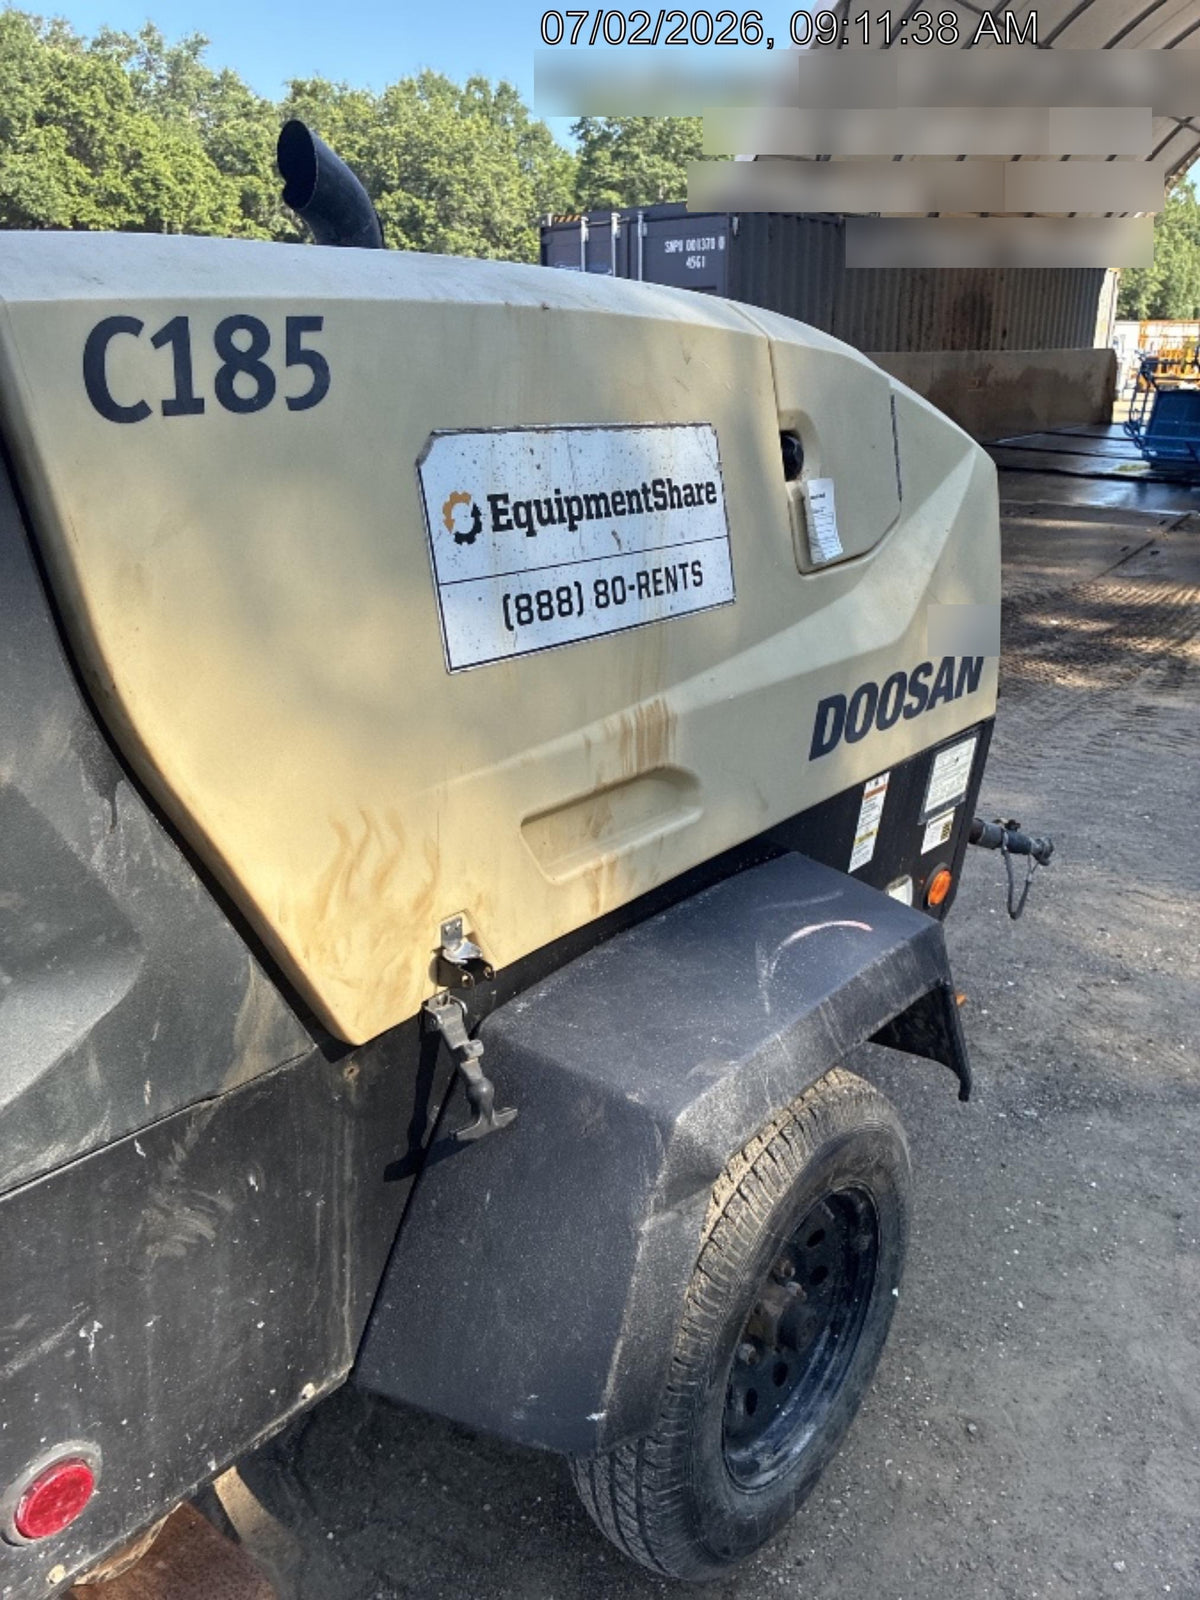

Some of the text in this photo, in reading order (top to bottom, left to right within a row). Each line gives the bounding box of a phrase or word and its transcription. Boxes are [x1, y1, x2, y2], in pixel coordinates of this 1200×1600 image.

[83, 313, 331, 424] C185
[487, 477, 718, 538] EquipmentShare
[502, 559, 704, 632] (888) 80-RENTS
[809, 656, 985, 762] DOOSAN
